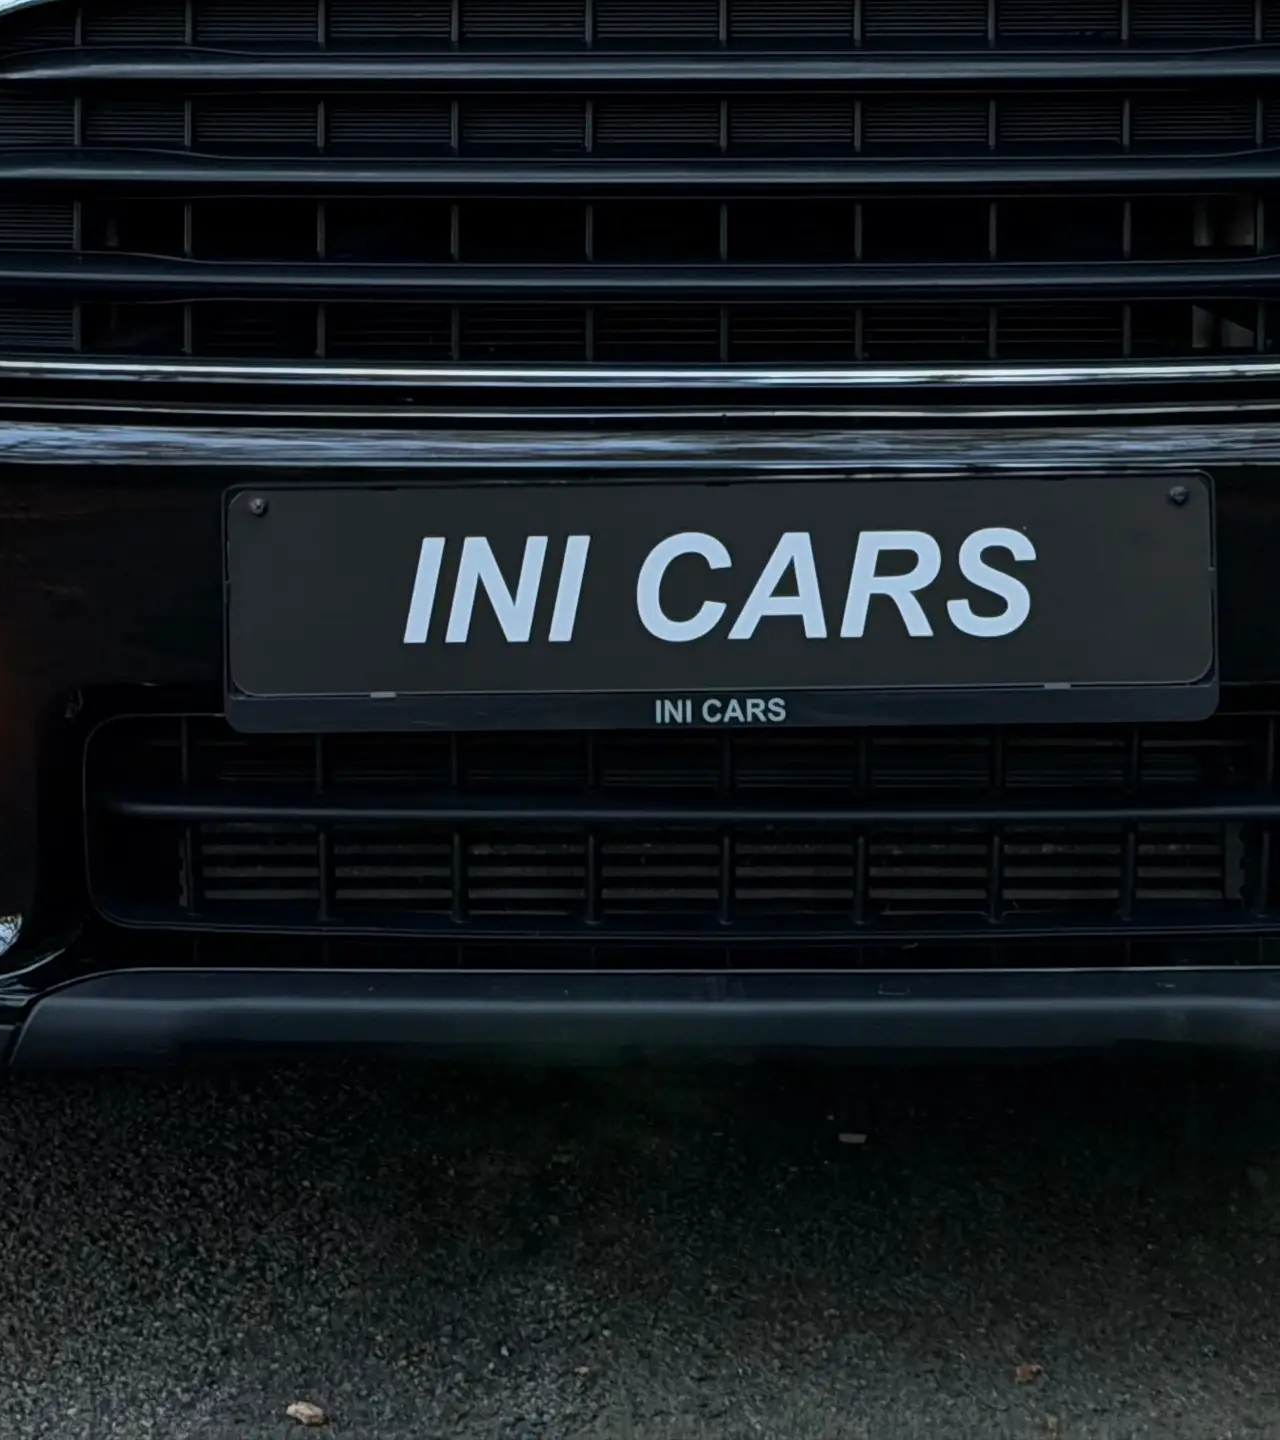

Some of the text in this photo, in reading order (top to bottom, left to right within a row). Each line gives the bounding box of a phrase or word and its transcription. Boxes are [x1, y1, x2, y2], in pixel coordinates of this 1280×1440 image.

[402, 526, 1038, 645] INI CARS
[654, 697, 787, 724] INI CARS
